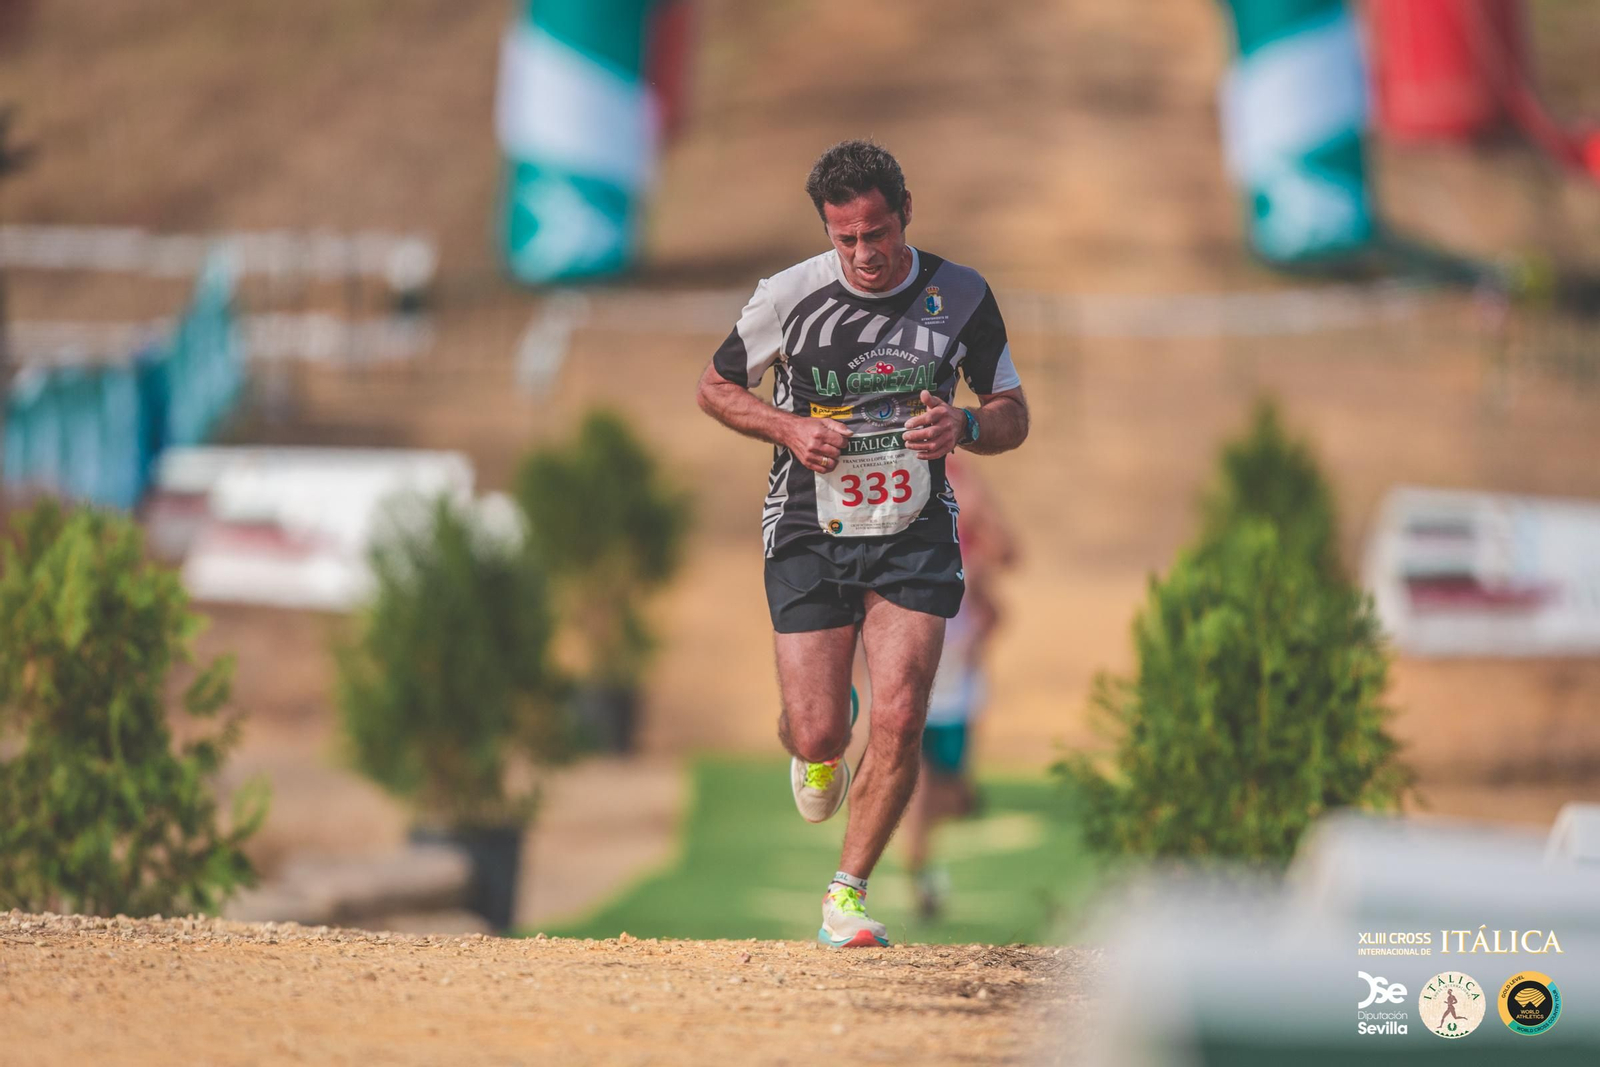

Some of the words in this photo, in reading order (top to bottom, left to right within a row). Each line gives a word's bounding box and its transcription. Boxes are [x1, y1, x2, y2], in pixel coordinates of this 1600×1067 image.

[848, 348, 919, 370] RESTAURANTE
[812, 366, 842, 396] LA
[846, 361, 937, 395] CEREZAL
[848, 436, 900, 452] ITÁLICA
[841, 469, 912, 507] 333
